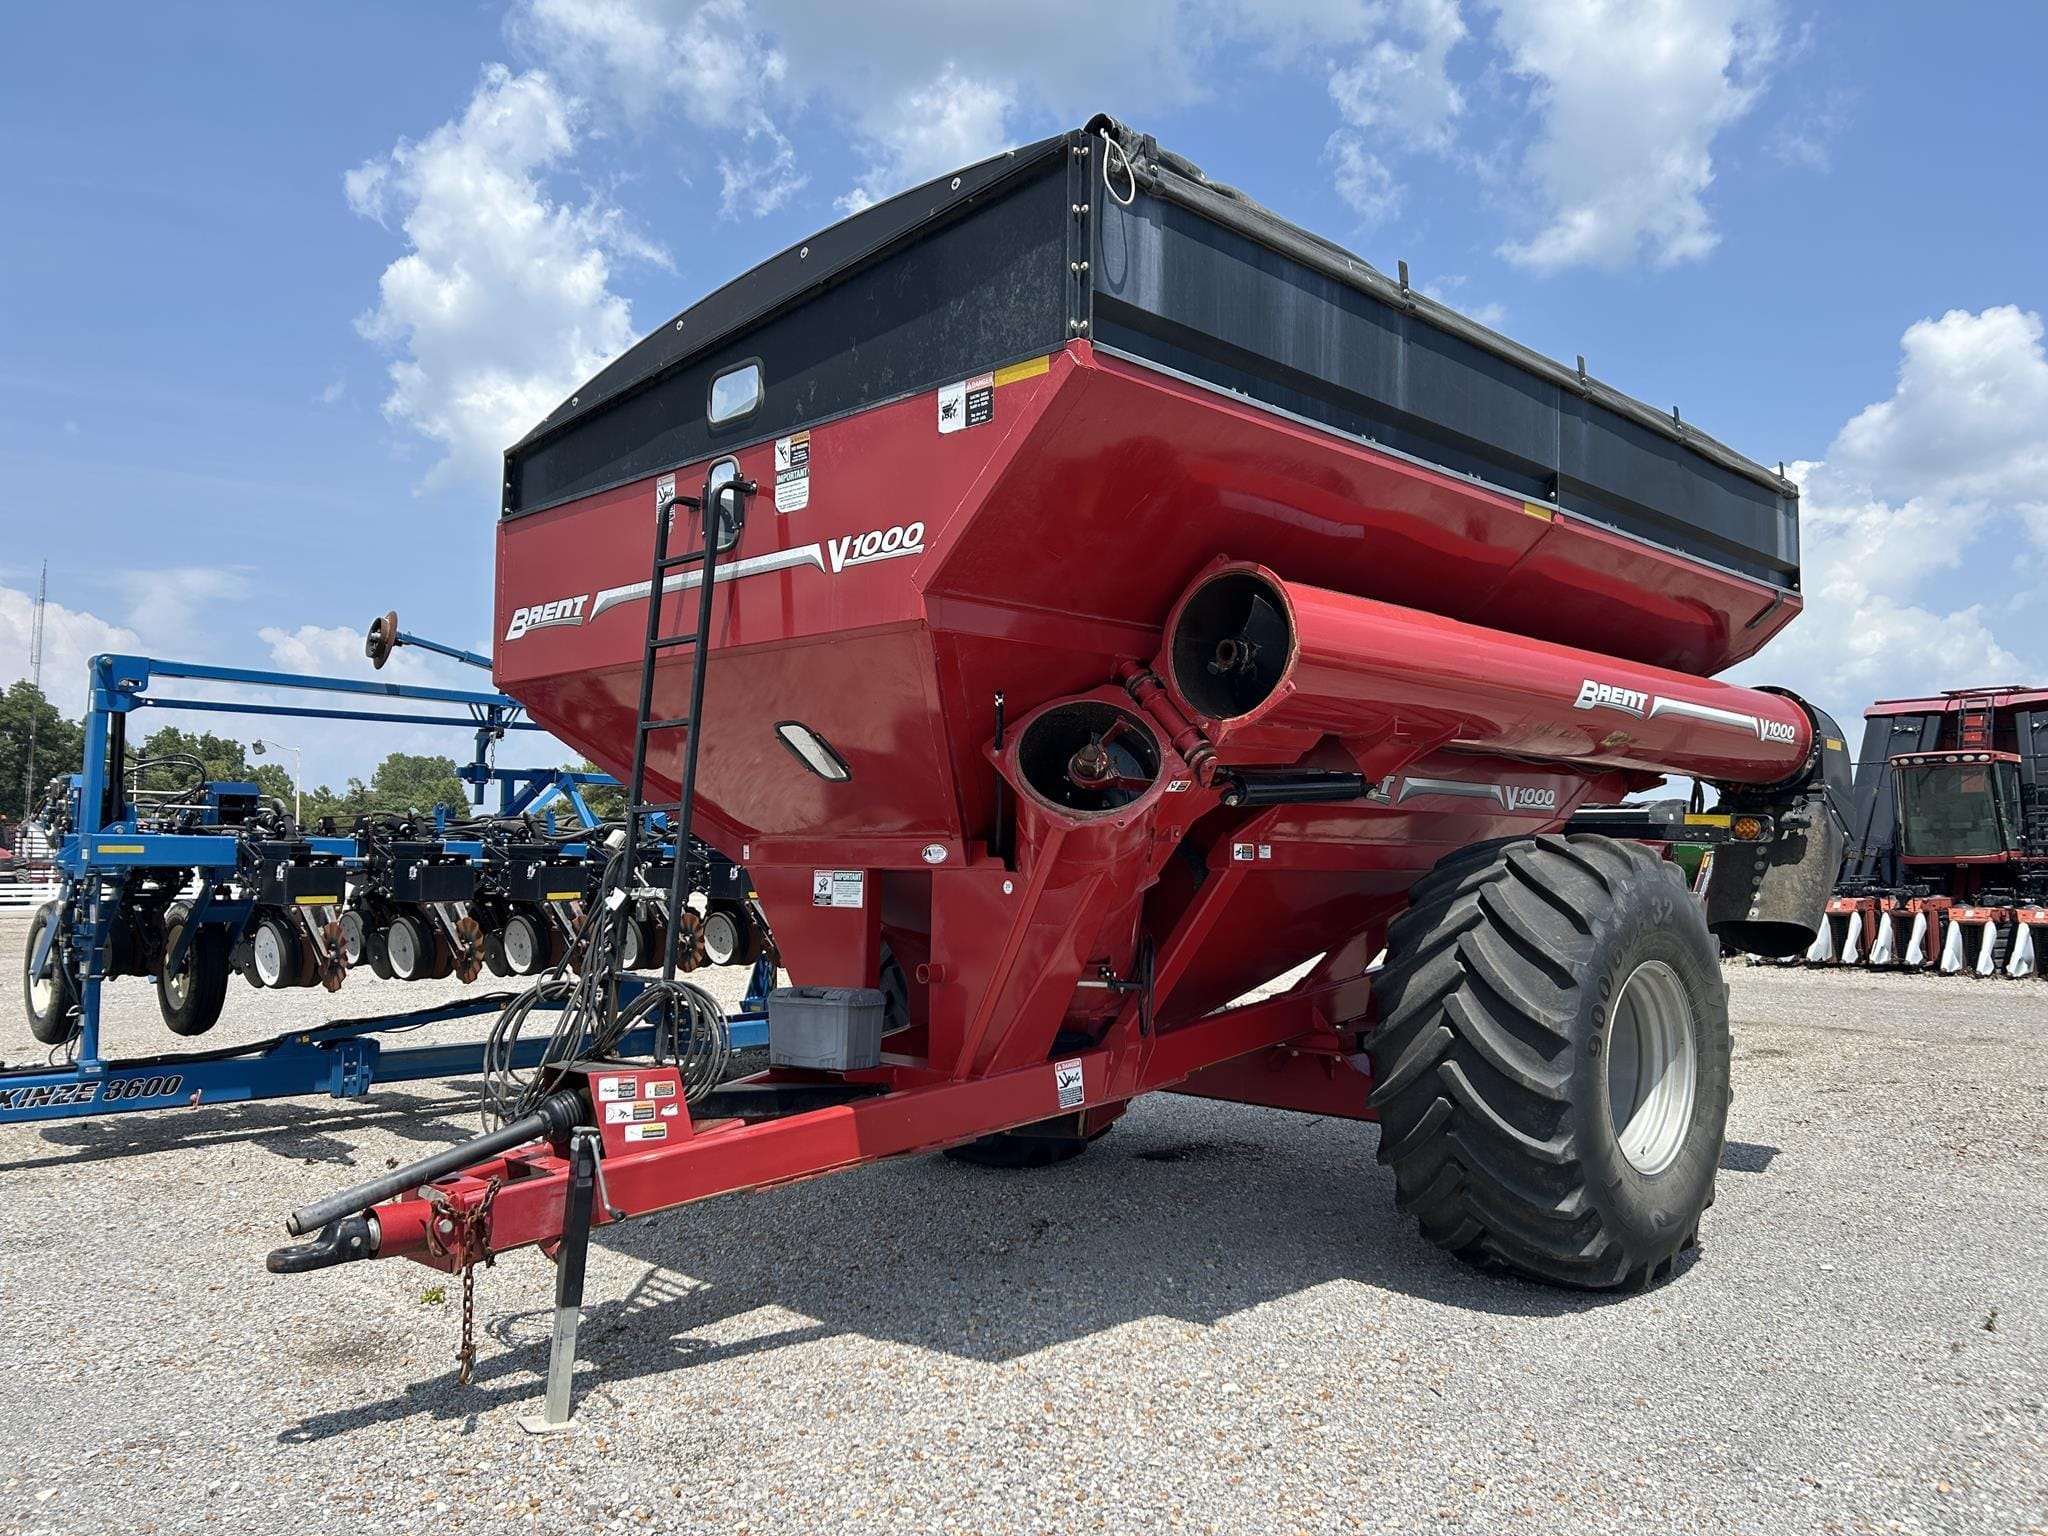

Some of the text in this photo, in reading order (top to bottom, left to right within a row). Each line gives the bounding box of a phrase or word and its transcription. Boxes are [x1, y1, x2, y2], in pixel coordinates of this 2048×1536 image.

[777, 468, 808, 484] IMPORTANT
[827, 521, 925, 573] V1000
[505, 594, 589, 641] BRENT
[1573, 679, 1648, 713] BRENT
[1760, 717, 1795, 742] V1000
[1505, 785, 1556, 811] V1000
[835, 872, 862, 881] IMPORTANT
[0, 1075, 183, 1111] KINZE 3600
